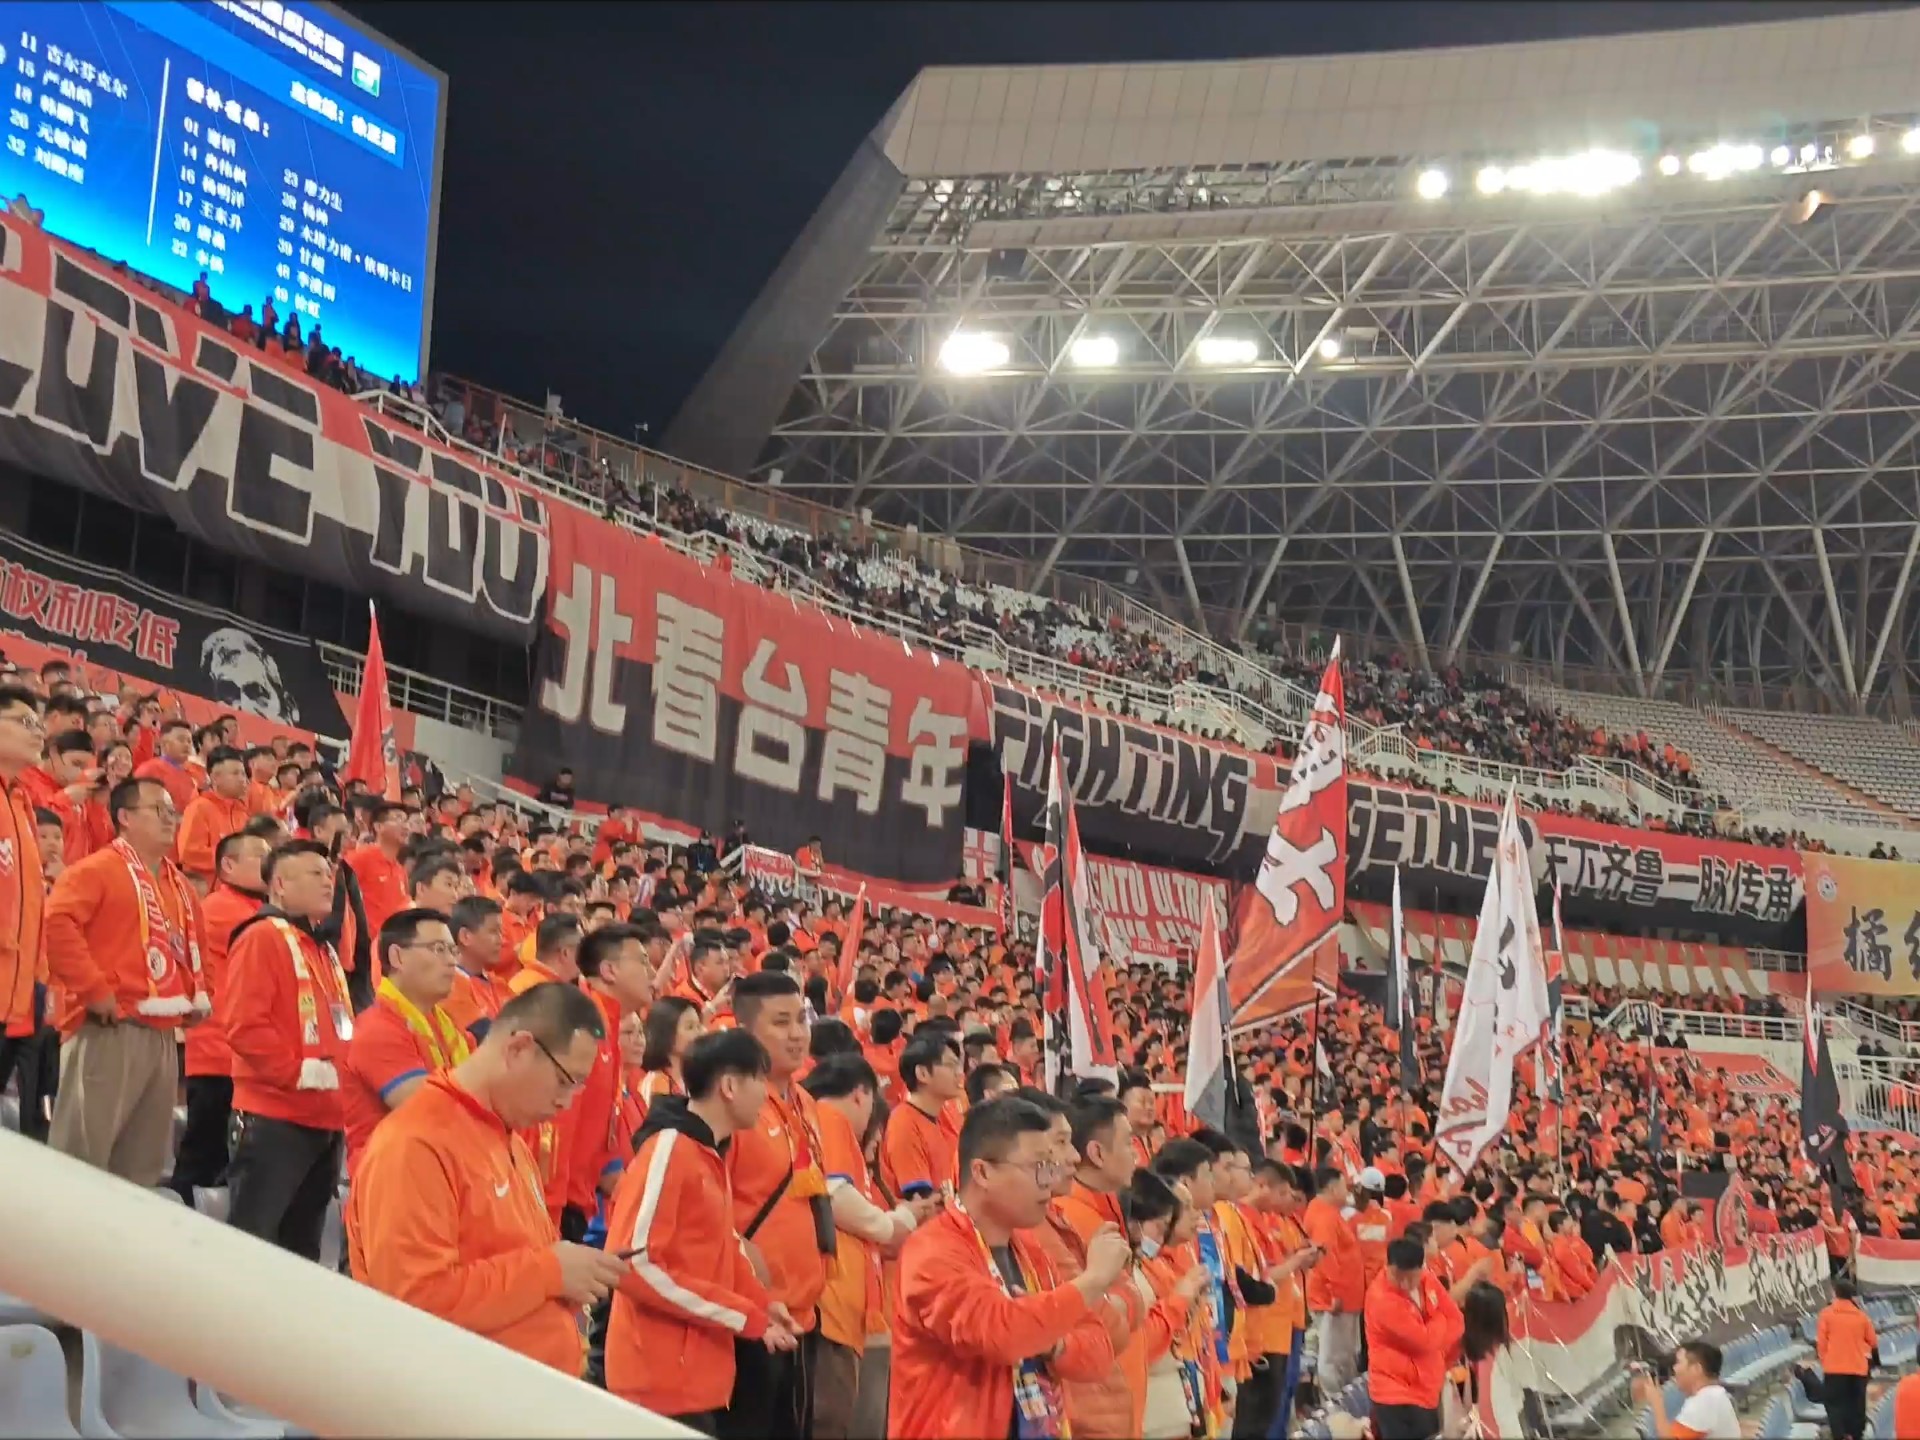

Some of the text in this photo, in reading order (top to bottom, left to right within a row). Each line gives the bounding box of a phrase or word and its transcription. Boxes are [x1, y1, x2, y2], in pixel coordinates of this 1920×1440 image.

[359, 412, 551, 626] YOU
[0, 557, 180, 670] 权利贬低
[541, 562, 969, 828] 北看台青年
[993, 682, 1249, 862] FIGHTING
[1542, 833, 1797, 922] 天下齐鲁一脉传承
